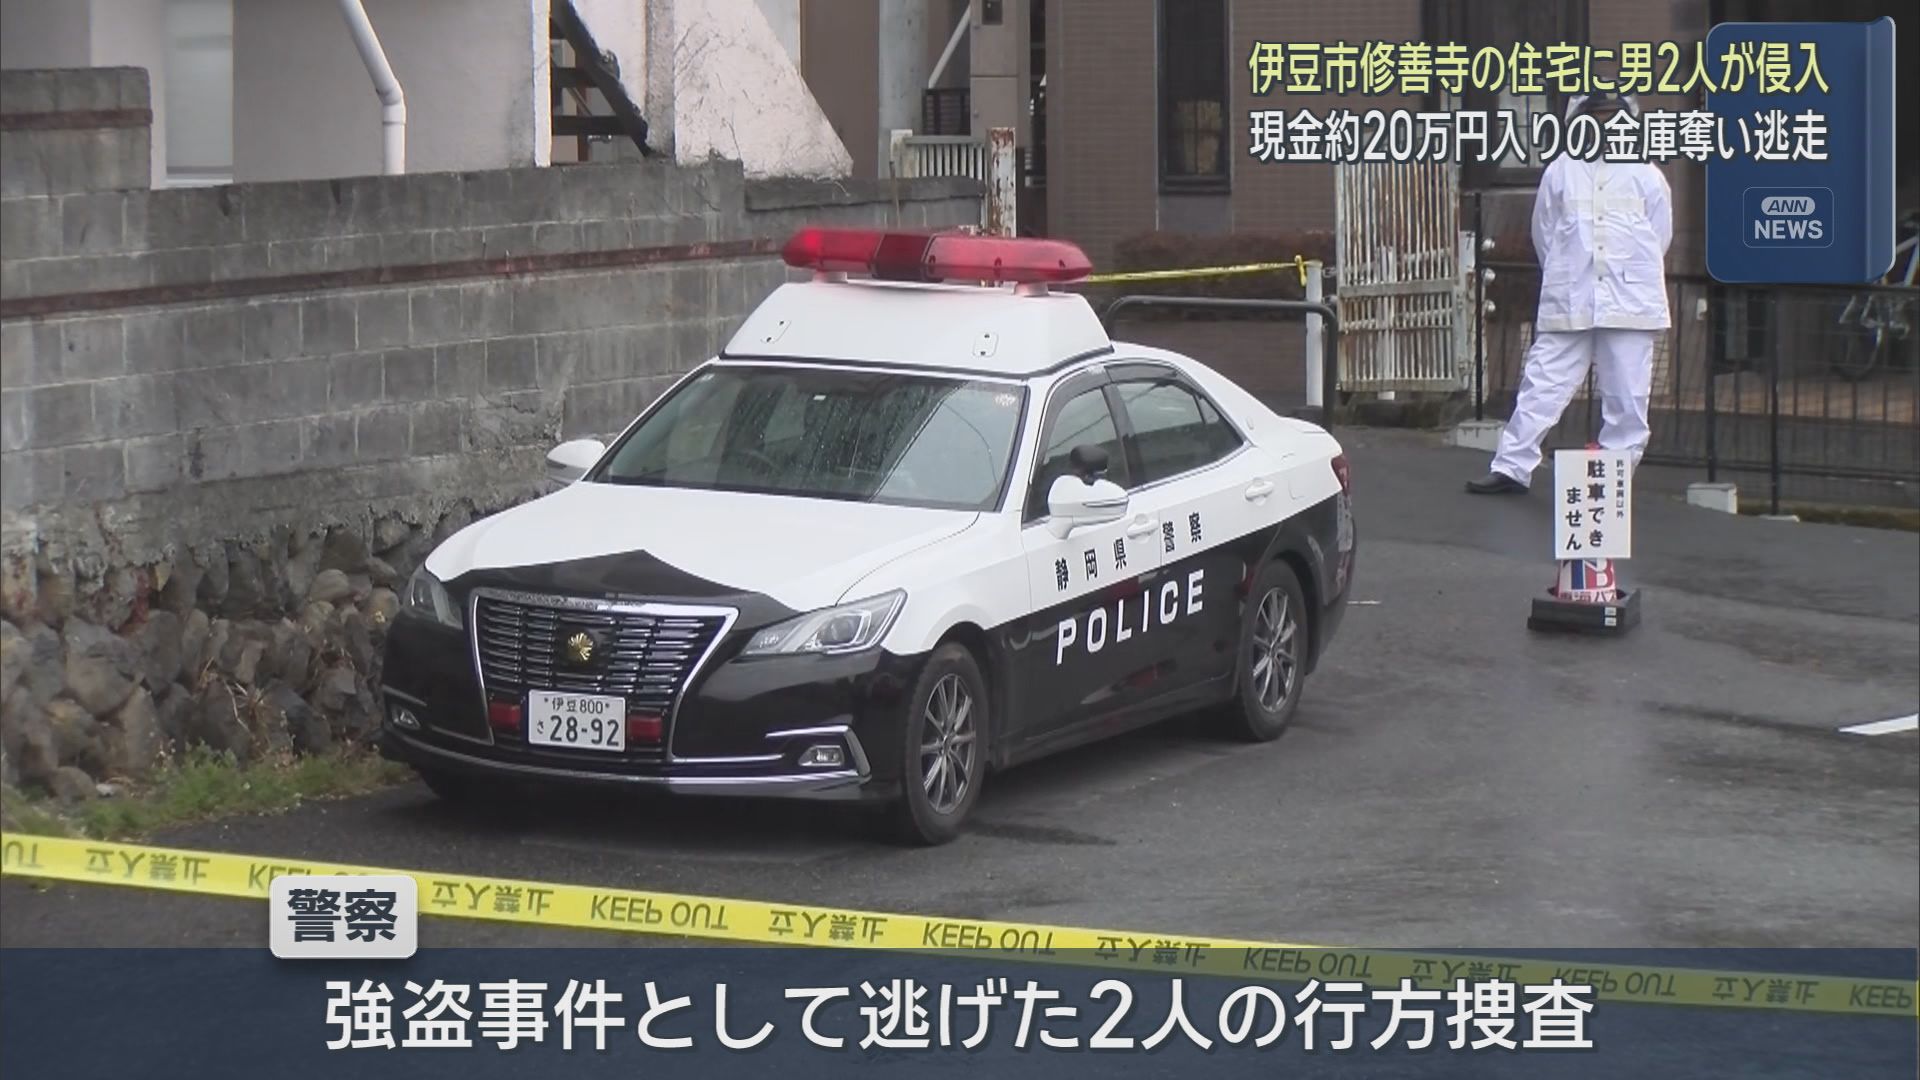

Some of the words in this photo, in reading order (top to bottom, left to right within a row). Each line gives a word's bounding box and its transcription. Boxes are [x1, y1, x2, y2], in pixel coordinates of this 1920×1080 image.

[1565, 487, 1582, 550] ません
[1587, 460, 1605, 547] 駐車でき
[1056, 569, 1204, 665] POLICE
[550, 715, 620, 747] 28-92
